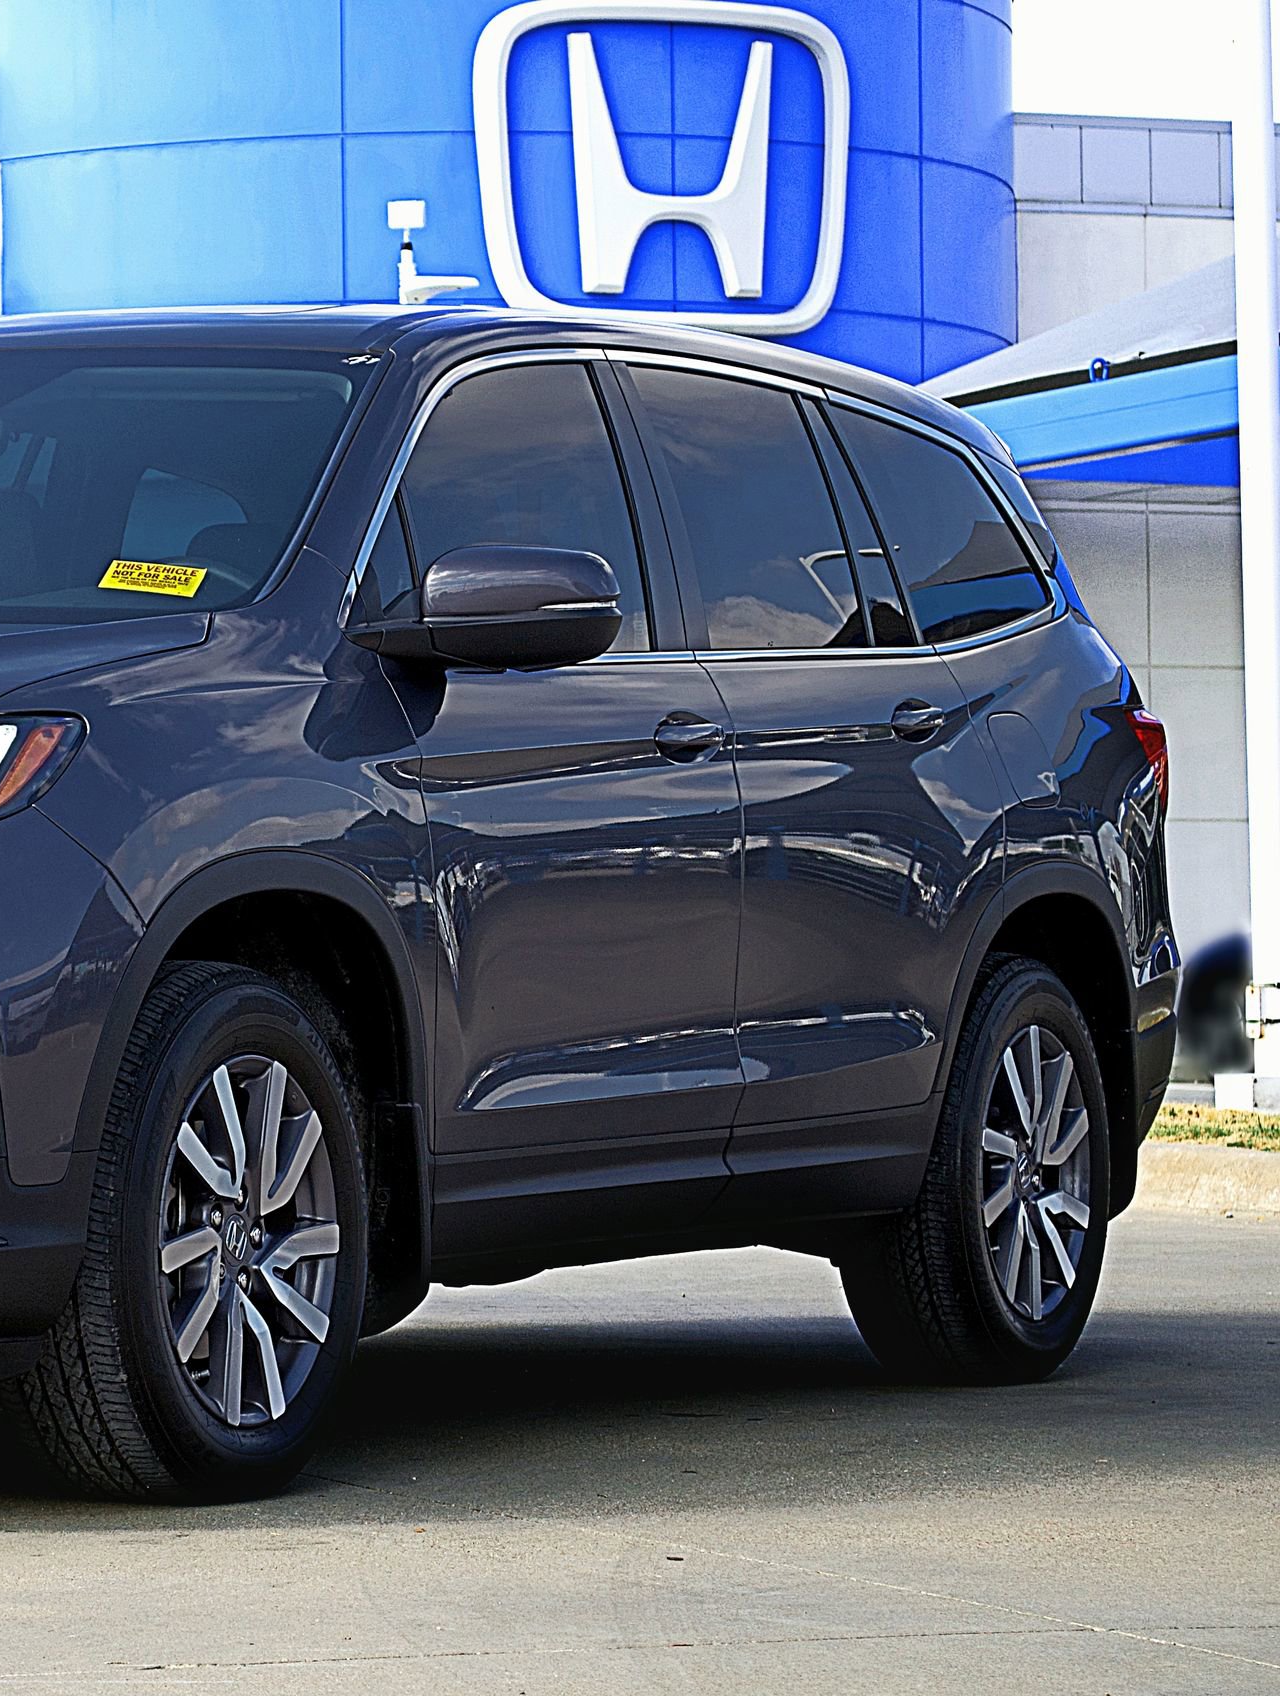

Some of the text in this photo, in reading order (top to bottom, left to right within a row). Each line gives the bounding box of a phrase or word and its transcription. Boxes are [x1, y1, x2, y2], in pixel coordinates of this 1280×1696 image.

[113, 569, 135, 577] NOT
[138, 572, 160, 580] FOR
[163, 574, 192, 583] SALE
[116, 562, 199, 577] THIS VEHICLE
